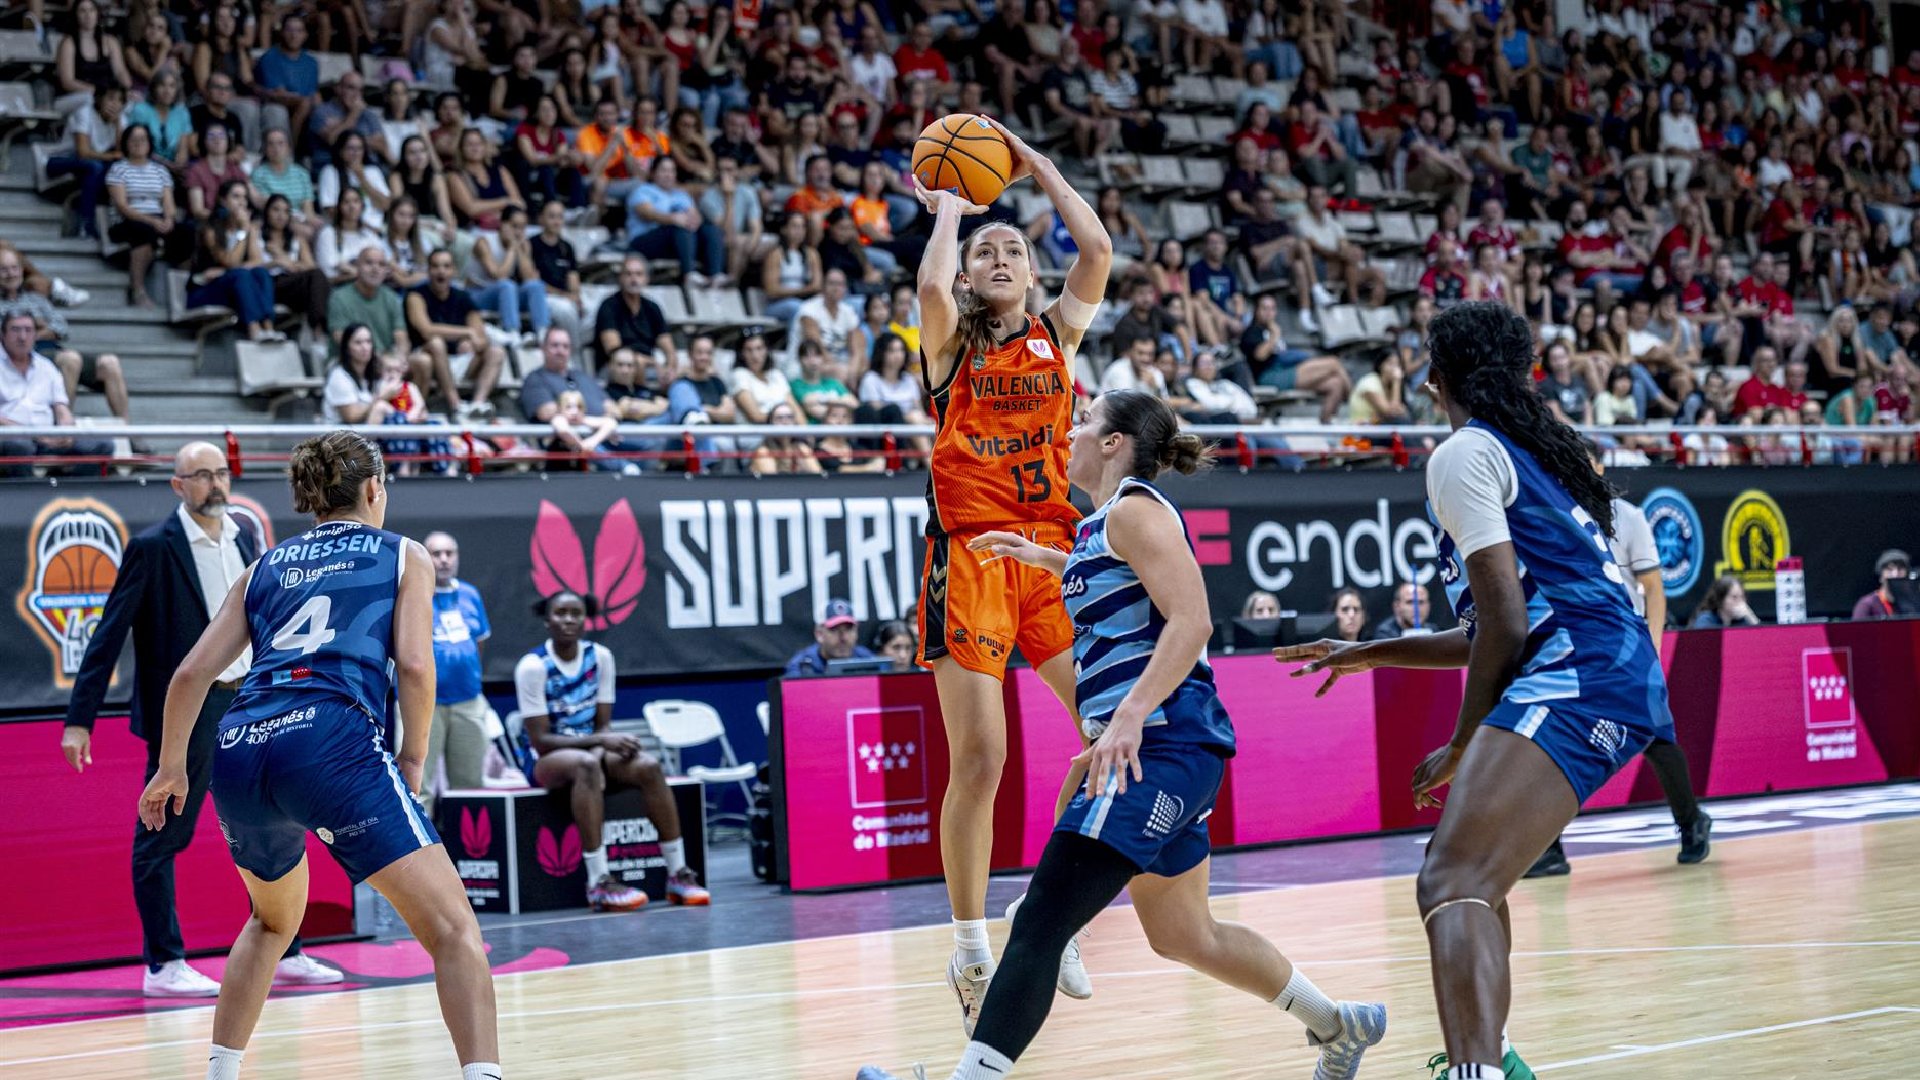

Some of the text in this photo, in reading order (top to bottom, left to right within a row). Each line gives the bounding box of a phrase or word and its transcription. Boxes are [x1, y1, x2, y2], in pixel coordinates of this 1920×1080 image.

[971, 372, 1065, 398] VALENCIA
[993, 399, 1041, 411] BASKET
[967, 424, 1054, 458] Vitaldi
[1011, 459, 1051, 504] 13
[268, 534, 383, 566] DRIESSEN
[271, 595, 335, 656] 4
[249, 709, 304, 736] Leganés
[853, 811, 929, 832] Comunidad
[854, 829, 930, 851] de Madrid
